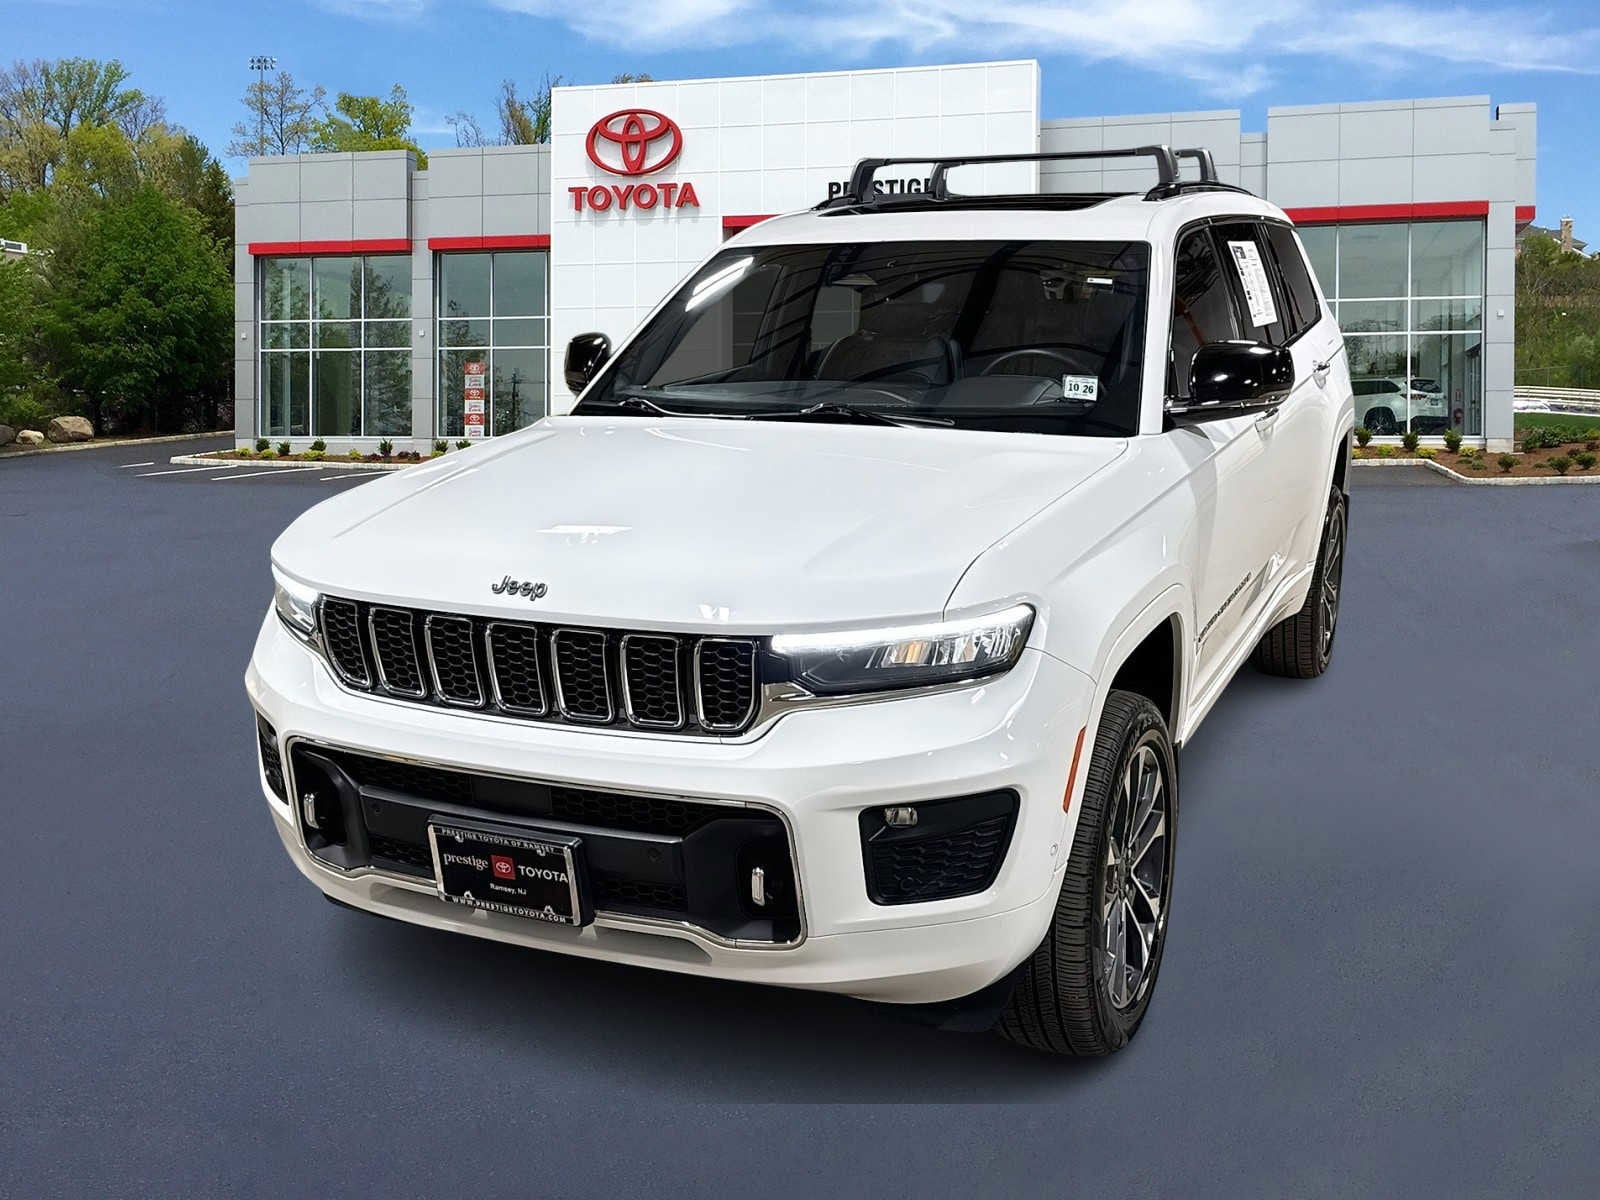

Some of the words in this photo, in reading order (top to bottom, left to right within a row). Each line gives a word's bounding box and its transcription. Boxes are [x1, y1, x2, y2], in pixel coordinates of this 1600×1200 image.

[568, 182, 700, 212] TOYOTA
[827, 178, 931, 200] PSTIG
[1068, 383, 1080, 391] 10
[1082, 385, 1094, 393] 26
[491, 575, 548, 602] Jeep
[479, 834, 509, 846] TOYOTA
[443, 853, 489, 871] prestige
[518, 865, 569, 883] TOYOTA
[452, 896, 567, 924] WWW.PRESTIGETOYOTA.COM
